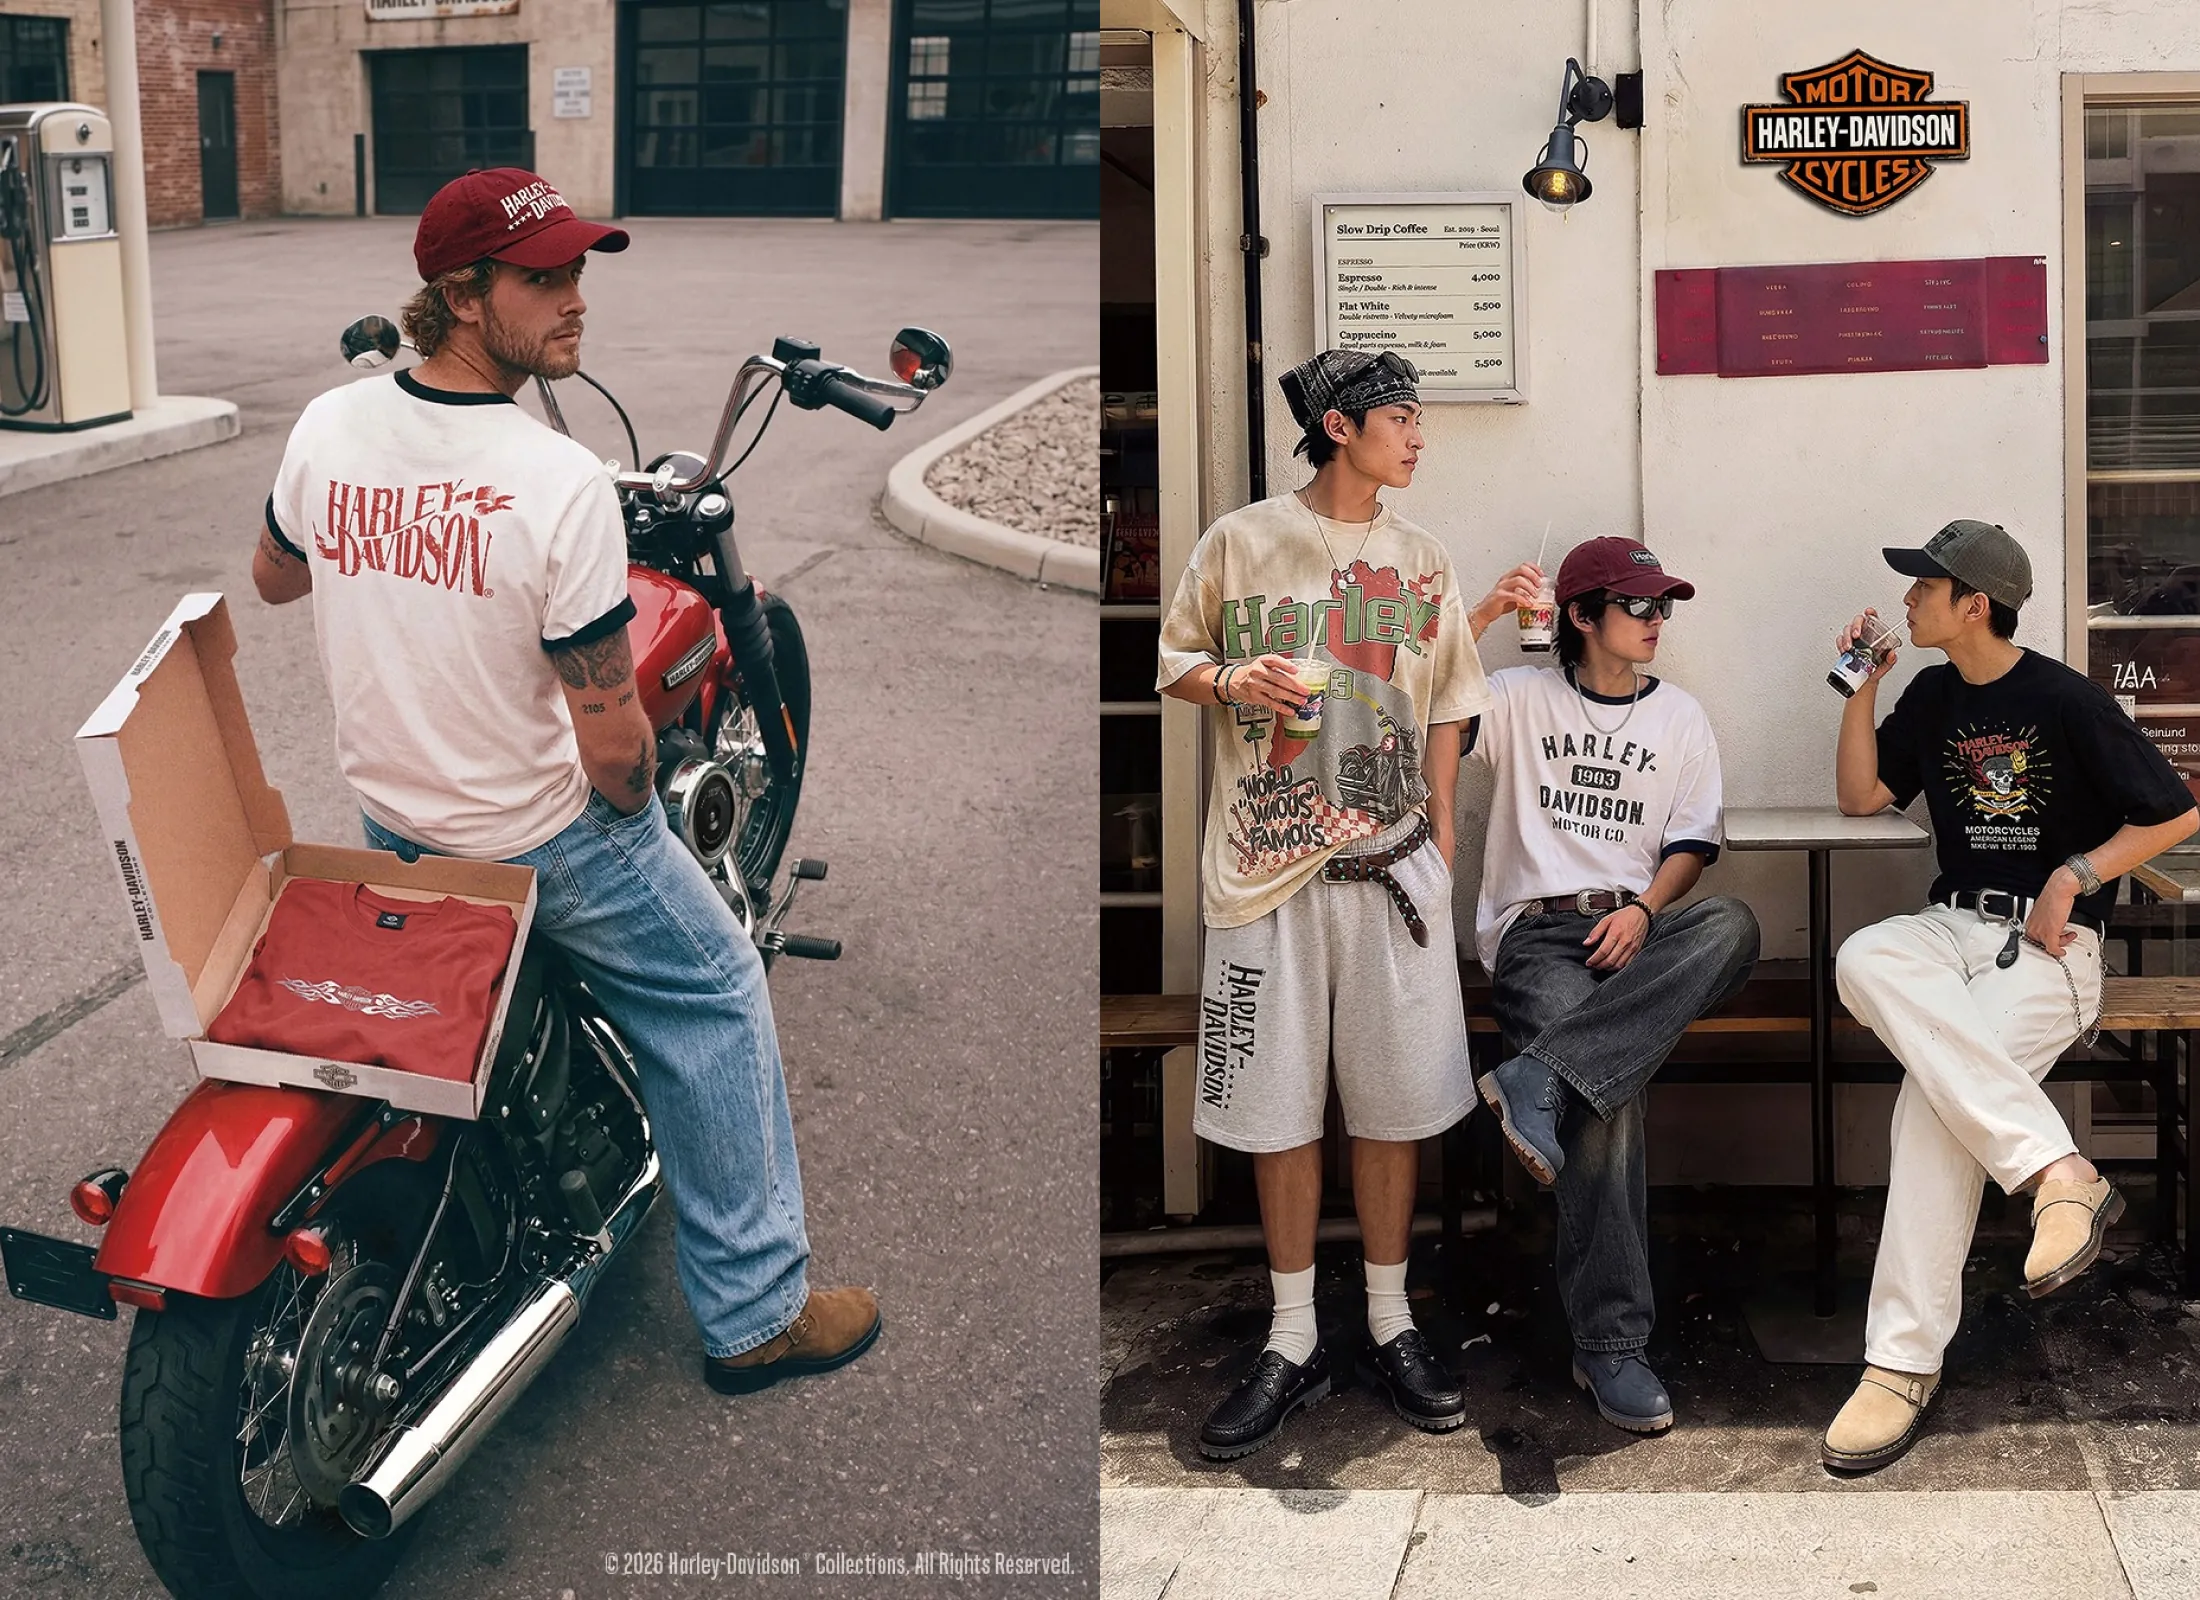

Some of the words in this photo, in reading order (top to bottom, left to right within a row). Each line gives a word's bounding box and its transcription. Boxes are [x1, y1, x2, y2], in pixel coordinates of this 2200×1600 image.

[1805, 65, 1911, 103] MOTOR
[1758, 114, 1956, 149] HARLEY-DAVIDSON
[1804, 159, 1910, 203] CYCLES
[1336, 224, 1364, 234] Slow
[1366, 224, 1391, 236] Drip
[1393, 224, 1428, 234] Coffee
[1443, 225, 1457, 233] Est.
[1480, 225, 1500, 233] Seoul
[1458, 241, 1476, 249] Price
[1476, 241, 1501, 250] (KRW)
[1338, 273, 1383, 284] Espresso
[1471, 273, 1501, 282] 4,000
[1337, 285, 1359, 293] Single
[1338, 301, 1358, 311] Flat
[1360, 301, 1390, 311] White
[1473, 301, 1502, 311] 5,500
[1338, 313, 1362, 321] Double
[1339, 330, 1397, 341] Cappuccino
[1473, 330, 1502, 340] 5,000
[1358, 342, 1376, 350] parts
[1428, 341, 1447, 350] foam
[1474, 359, 1503, 368] 5,500
[1428, 369, 1458, 377] available
[336, 513, 492, 597] DAVIDSON
[1223, 585, 1440, 659] Harley
[1541, 732, 1657, 774] HARLEY-
[1970, 739, 2030, 763] DAVIDSON
[1576, 767, 1617, 788] 1903
[1551, 816, 1601, 840] MOTOR
[1603, 827, 1629, 844] CO.
[1964, 825, 2041, 836] MOTORCYCLES
[1249, 823, 1326, 853] FAMOUS
[113, 838, 155, 942] HARLEY-DAVIDSON
[1227, 962, 1266, 1070] HARLEY-
[1202, 996, 1228, 1109] DAVIDSON
